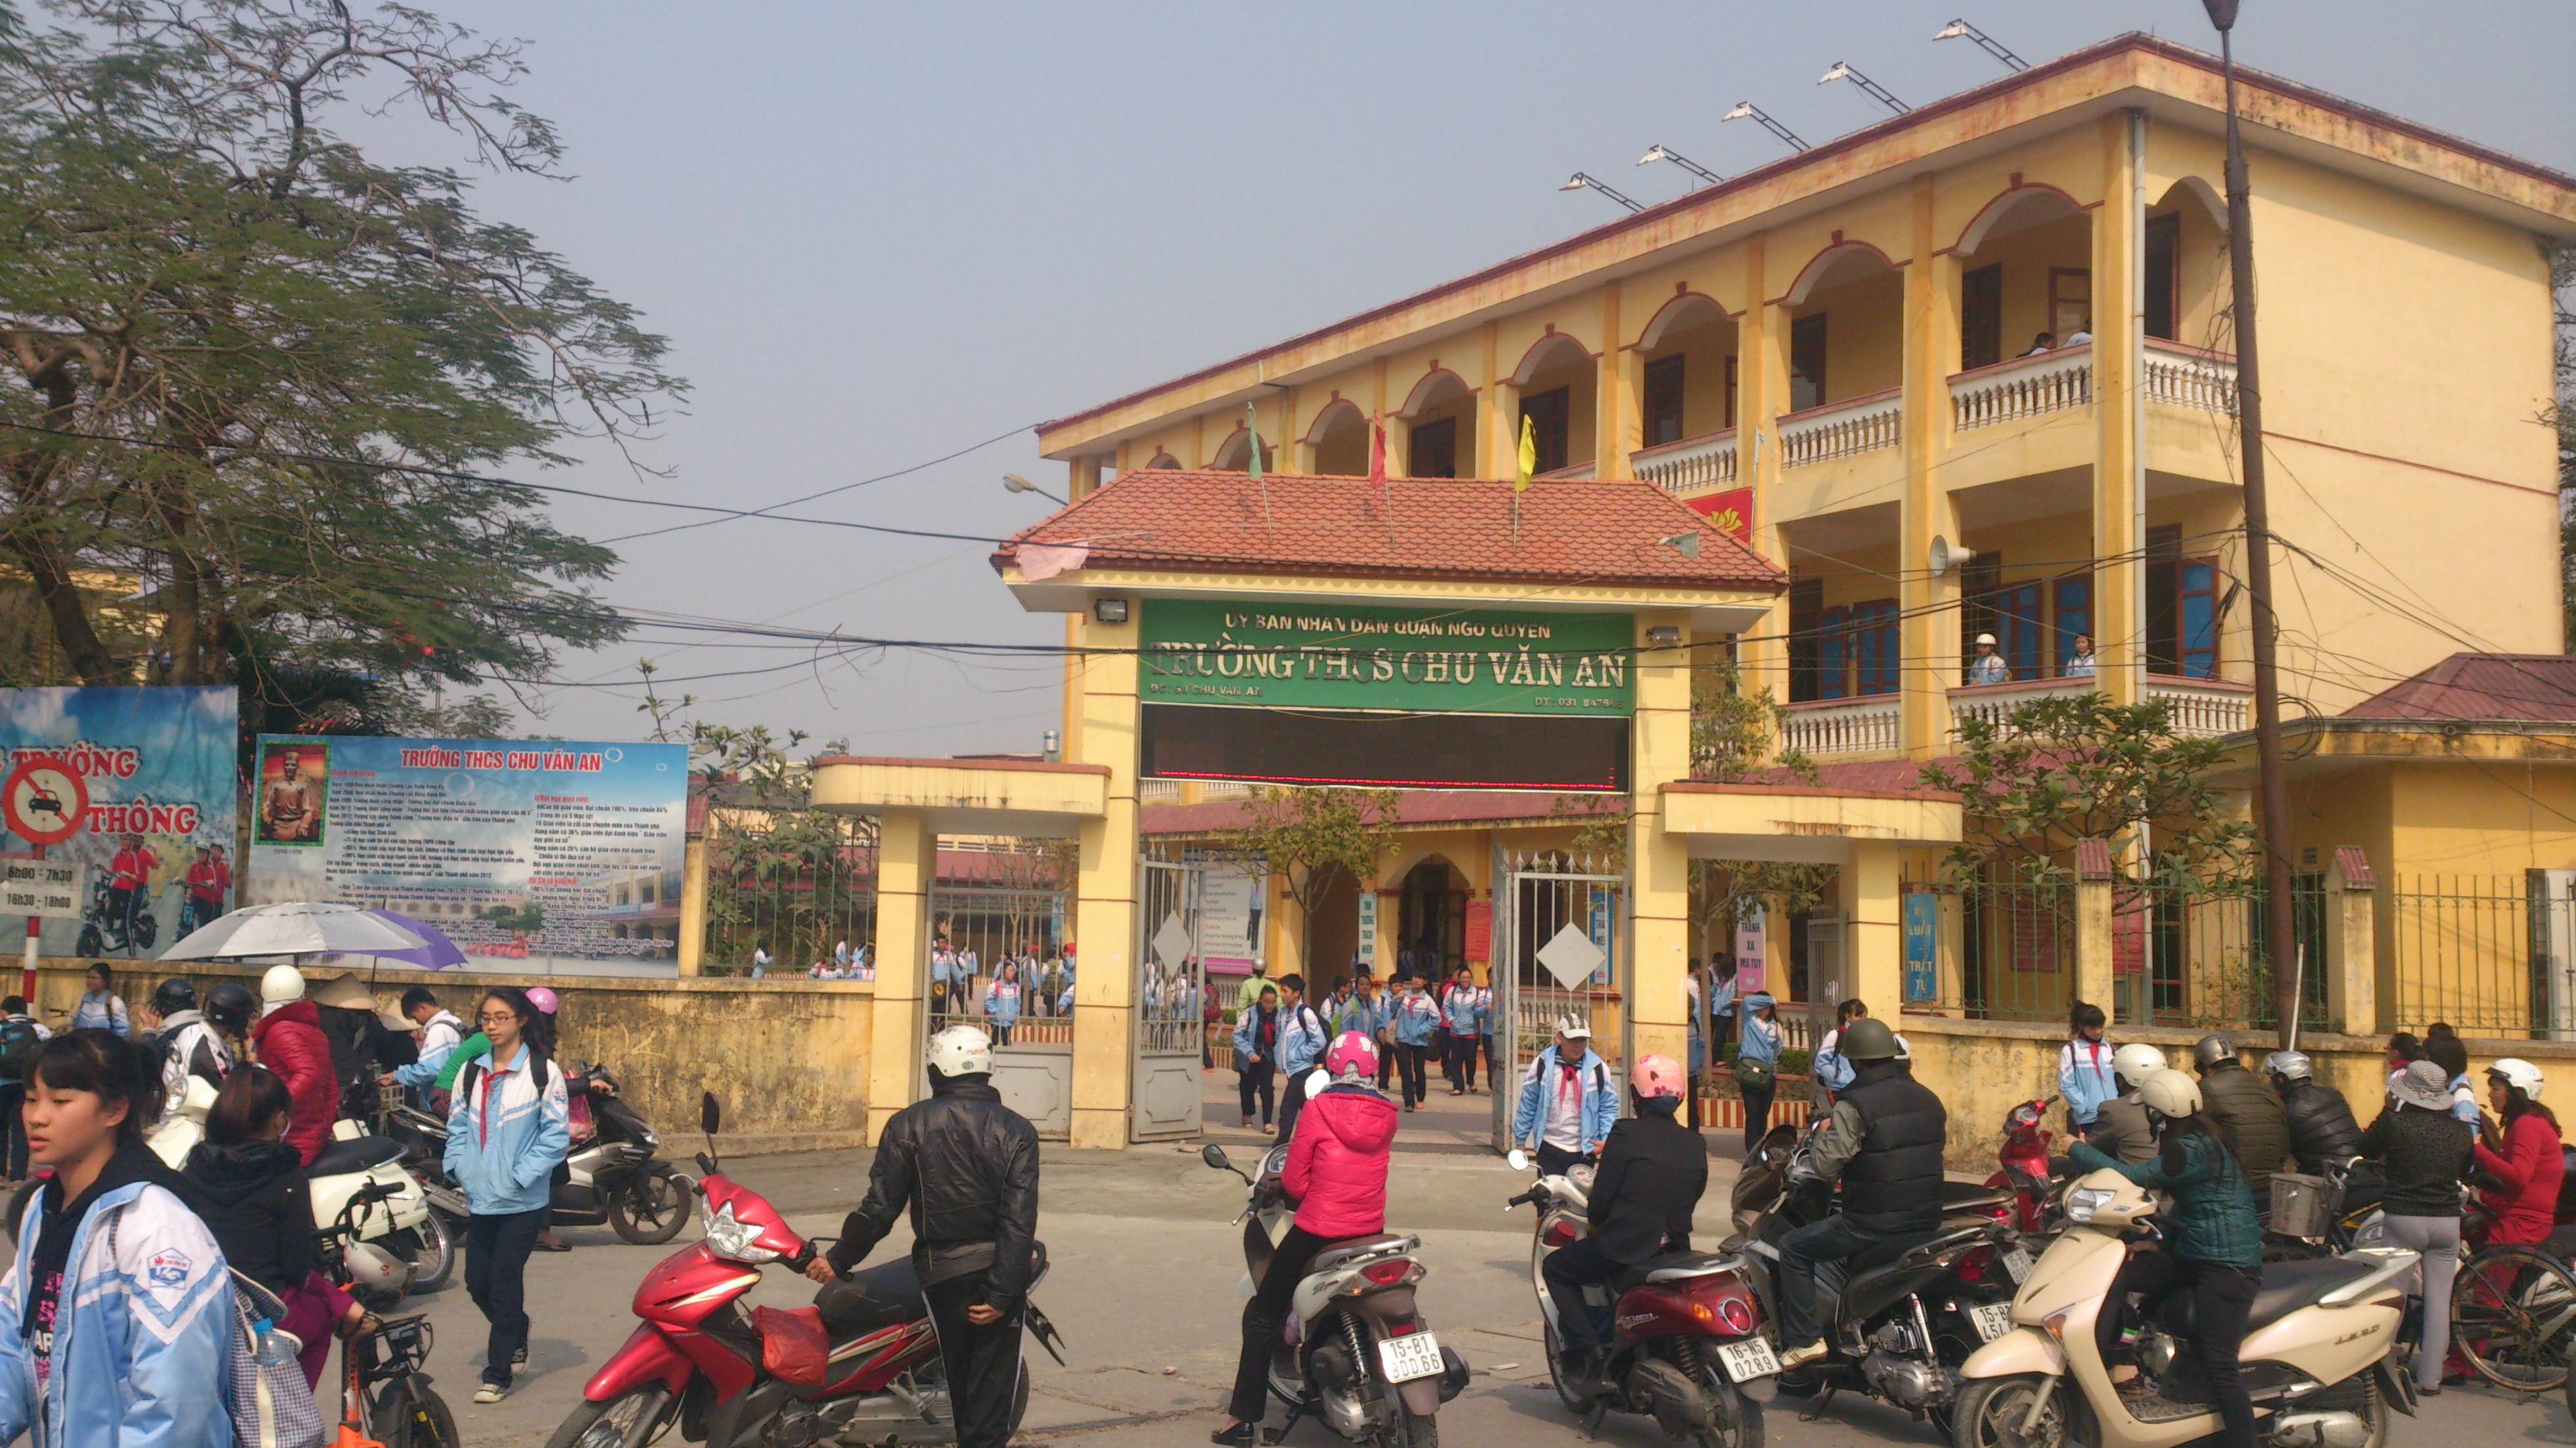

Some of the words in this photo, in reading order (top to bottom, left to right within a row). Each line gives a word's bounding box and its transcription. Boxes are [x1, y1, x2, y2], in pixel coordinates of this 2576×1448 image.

[1255, 614, 1292, 630] BAN
[1297, 614, 1346, 632] NHÂN
[1351, 616, 1388, 633] DÂN
[1394, 618, 1442, 639] QUẬN
[1448, 620, 1486, 637] NGÔ
[1149, 631, 1295, 679] TRƯỜNG
[1300, 646, 1394, 683] THCS
[1402, 650, 1478, 684] CHU
[1487, 643, 1565, 686] VĂN
[1571, 655, 1626, 688] AN
[1193, 685, 1216, 695] CHU
[1558, 697, 1577, 707] 031
[402, 746, 460, 768] TRƯỜNG
[466, 750, 502, 769] THCS
[507, 751, 539, 770] CHU
[544, 749, 574, 771] VĂN
[579, 753, 601, 771] AN
[87, 798, 196, 834] THÔNG
[8, 866, 35, 879] 6h00
[46, 869, 72, 882] 7h30
[7, 894, 34, 906] 16h30
[44, 895, 70, 909] 18h00
[1747, 940, 1755, 951] XA
[1389, 1336, 1429, 1359] 15-B1
[1726, 1340, 1765, 1361] 16-N5
[1734, 1355, 1774, 1378] 0289
